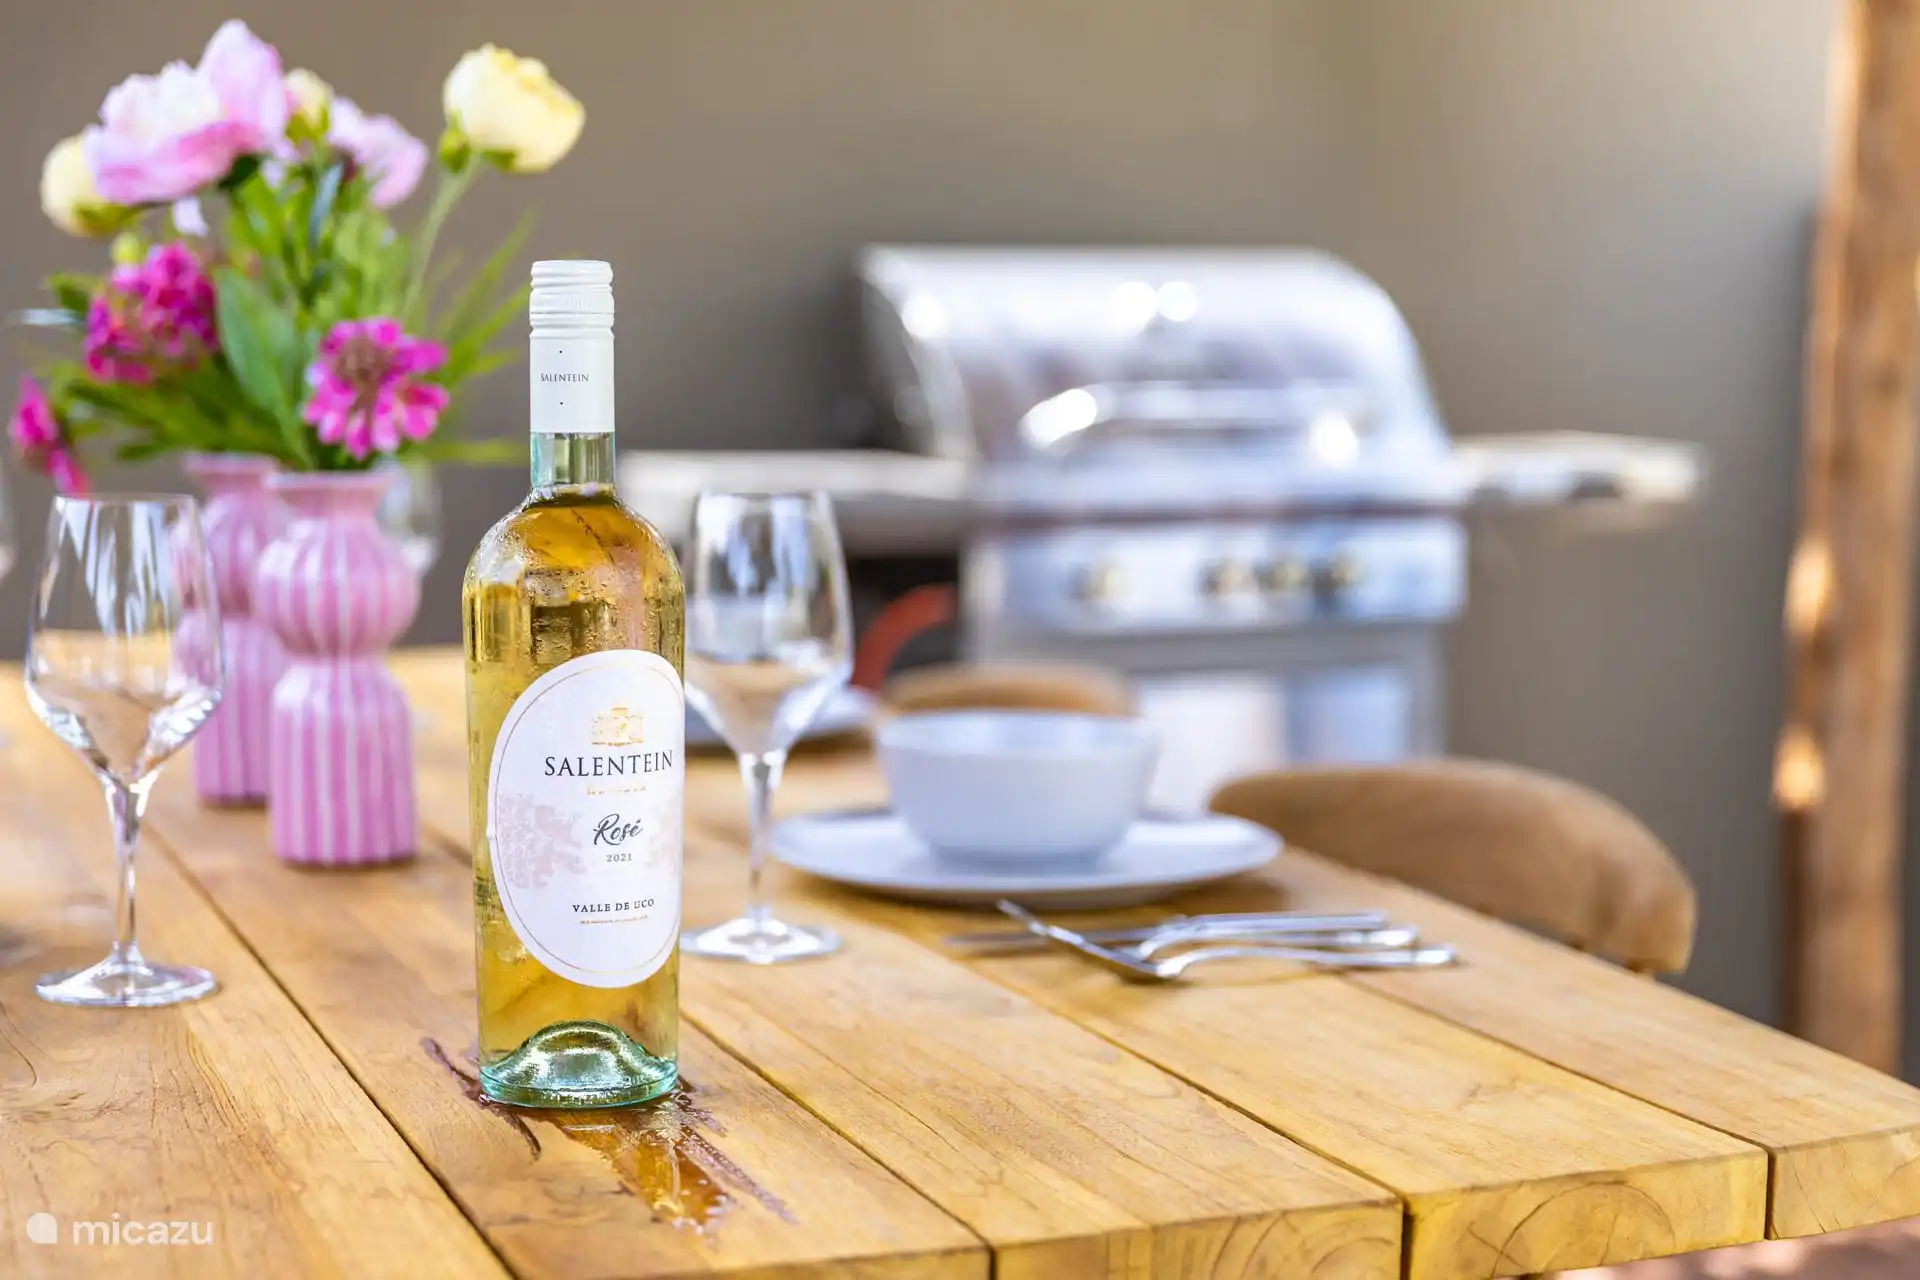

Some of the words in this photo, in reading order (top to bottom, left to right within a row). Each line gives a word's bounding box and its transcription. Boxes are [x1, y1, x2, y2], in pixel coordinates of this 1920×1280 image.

[540, 373, 589, 382] SALENTEIN
[544, 749, 673, 777] SALENTEIN
[593, 813, 644, 846] Rosé
[606, 853, 633, 863] 2021
[572, 904, 612, 913] VALLE
[615, 902, 630, 912] DE
[634, 898, 655, 910] UCO
